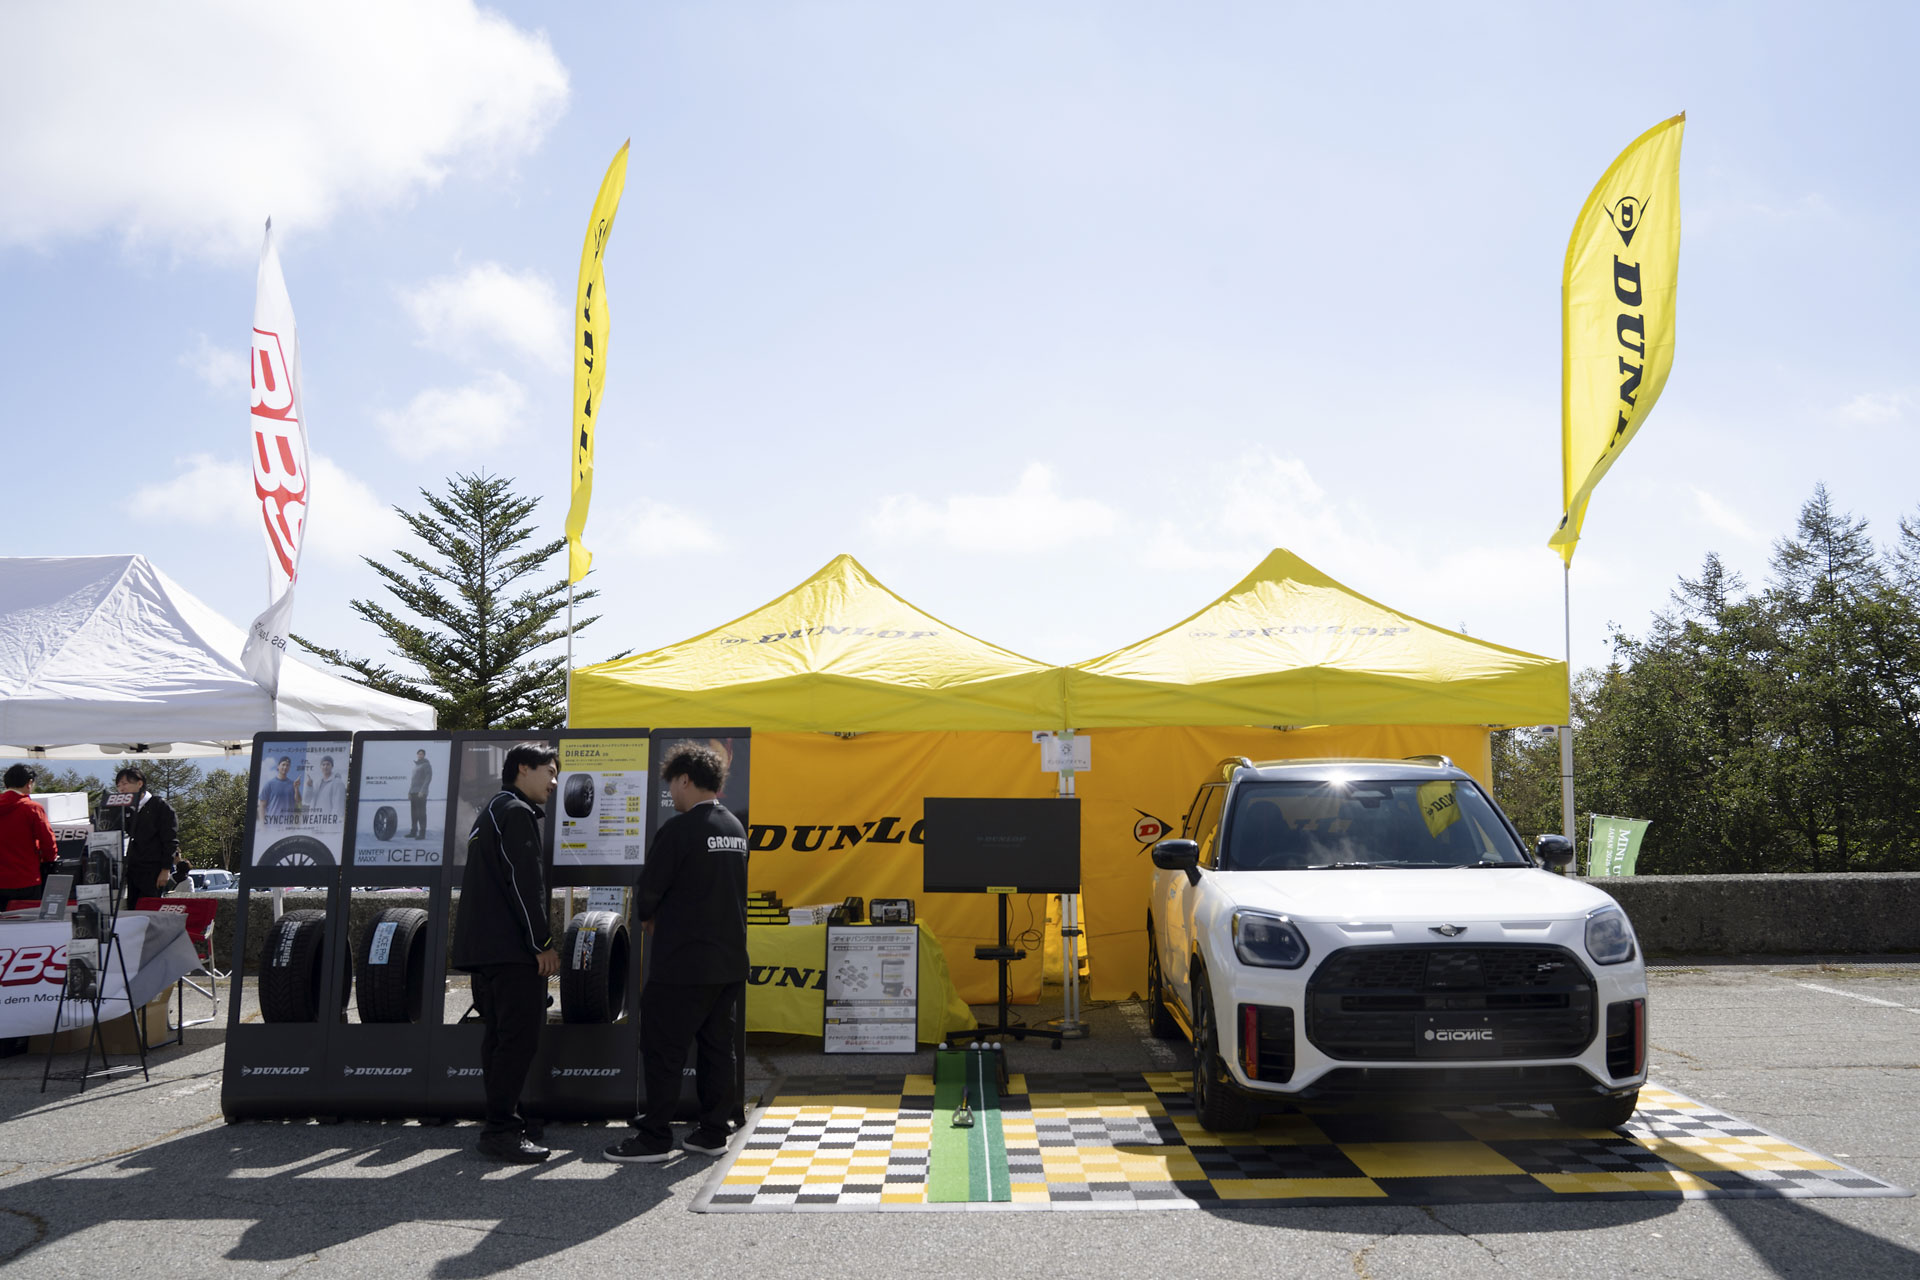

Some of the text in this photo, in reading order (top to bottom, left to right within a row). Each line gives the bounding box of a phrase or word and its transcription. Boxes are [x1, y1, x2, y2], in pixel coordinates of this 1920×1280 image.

[1597, 254, 1645, 469] DUNL
[753, 625, 939, 645] DUNLOP
[1223, 625, 1411, 639] DUNLOP
[106, 793, 134, 806] BBS
[264, 814, 338, 825] SYNCHRO WEATHER
[707, 836, 747, 851] GROWTH
[1607, 827, 1615, 849] JAPAN
[387, 849, 412, 862] ICE
[415, 849, 440, 862] Pro
[1612, 828, 1631, 876] MINI U
[159, 904, 186, 914] BBS
[380, 935, 390, 947] ICE
[378, 948, 387, 961] Pro
[4, 996, 30, 1005] dem
[1436, 1030, 1493, 1041] GIOMIC
[252, 1067, 309, 1075] DUNLOP
[354, 1067, 412, 1075] DUNLOP
[563, 1068, 621, 1076] DUNLOP
